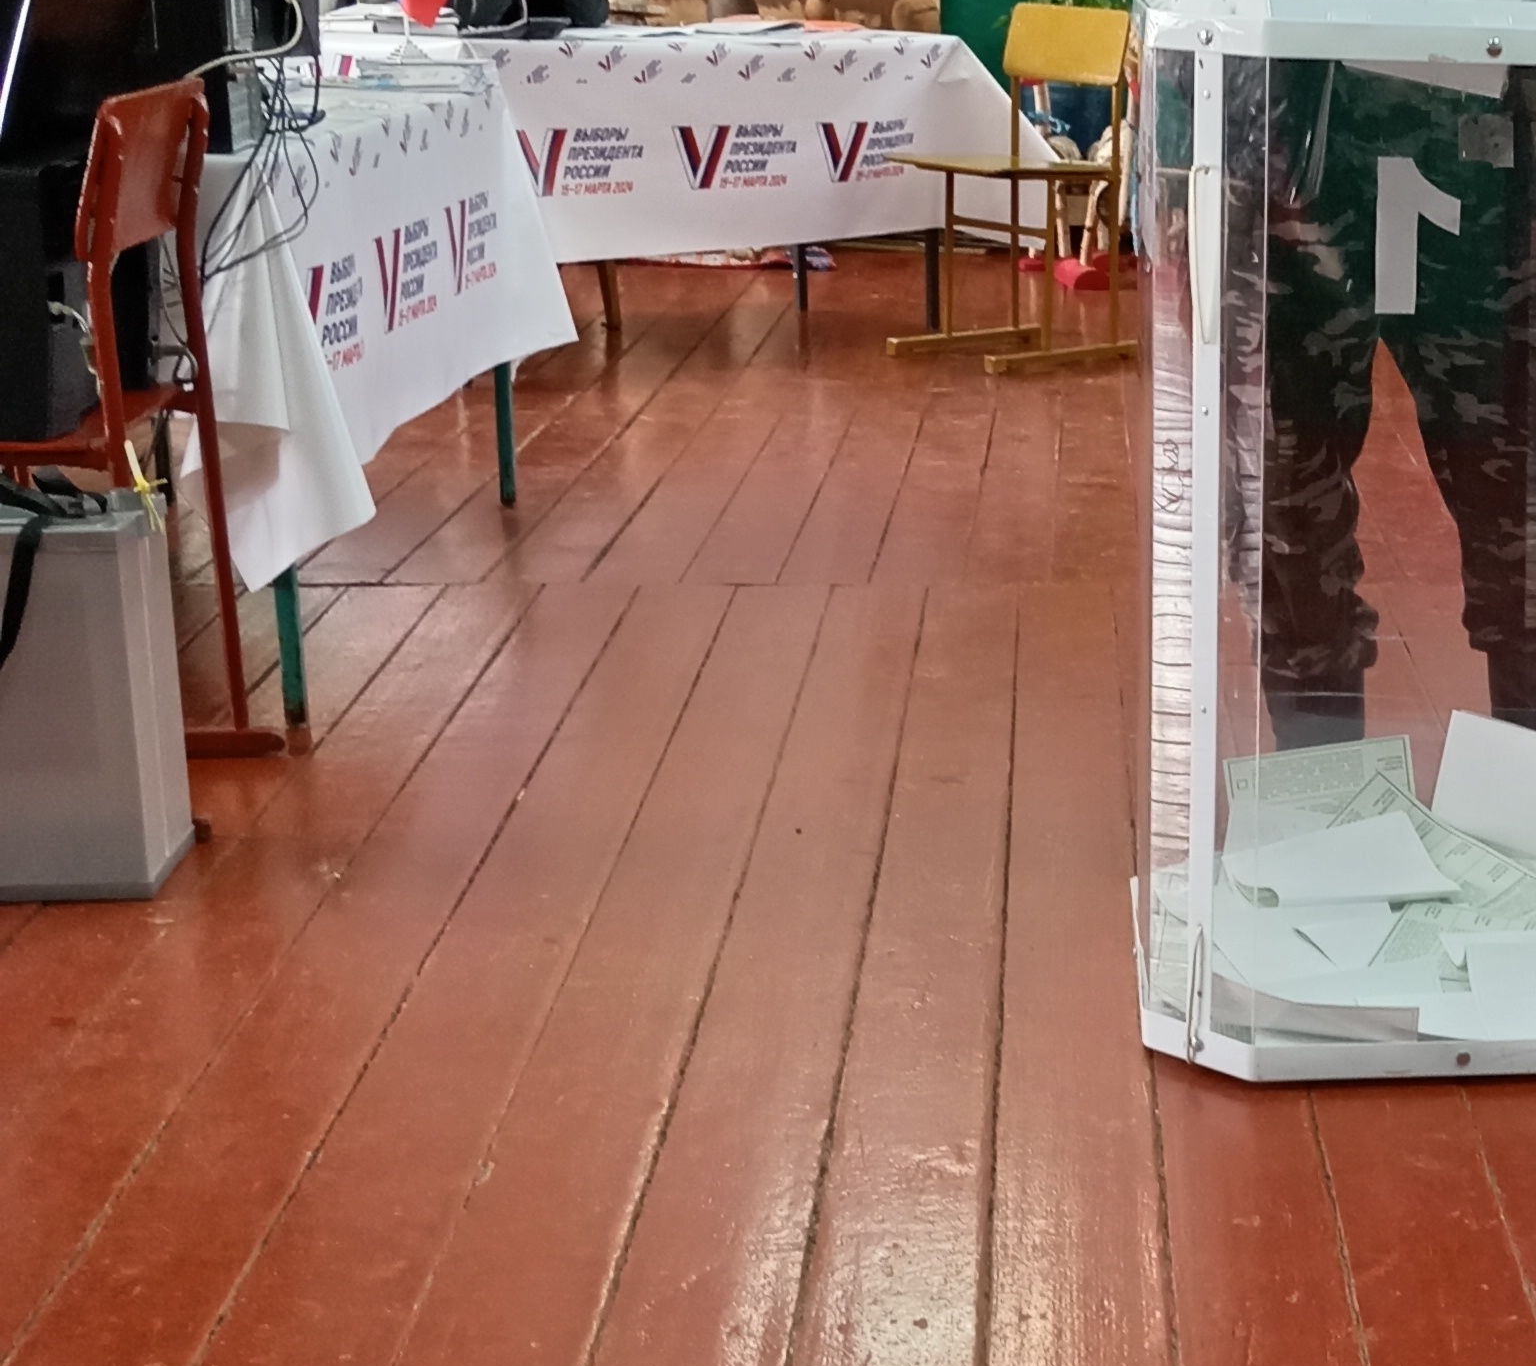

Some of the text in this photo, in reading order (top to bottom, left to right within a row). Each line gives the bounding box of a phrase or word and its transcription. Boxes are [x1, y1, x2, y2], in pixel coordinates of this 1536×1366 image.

[573, 126, 629, 142] ВЫБОРЫ
[567, 145, 644, 162] ПРЕЗИДЕНТА
[563, 164, 611, 180] РОССИИ
